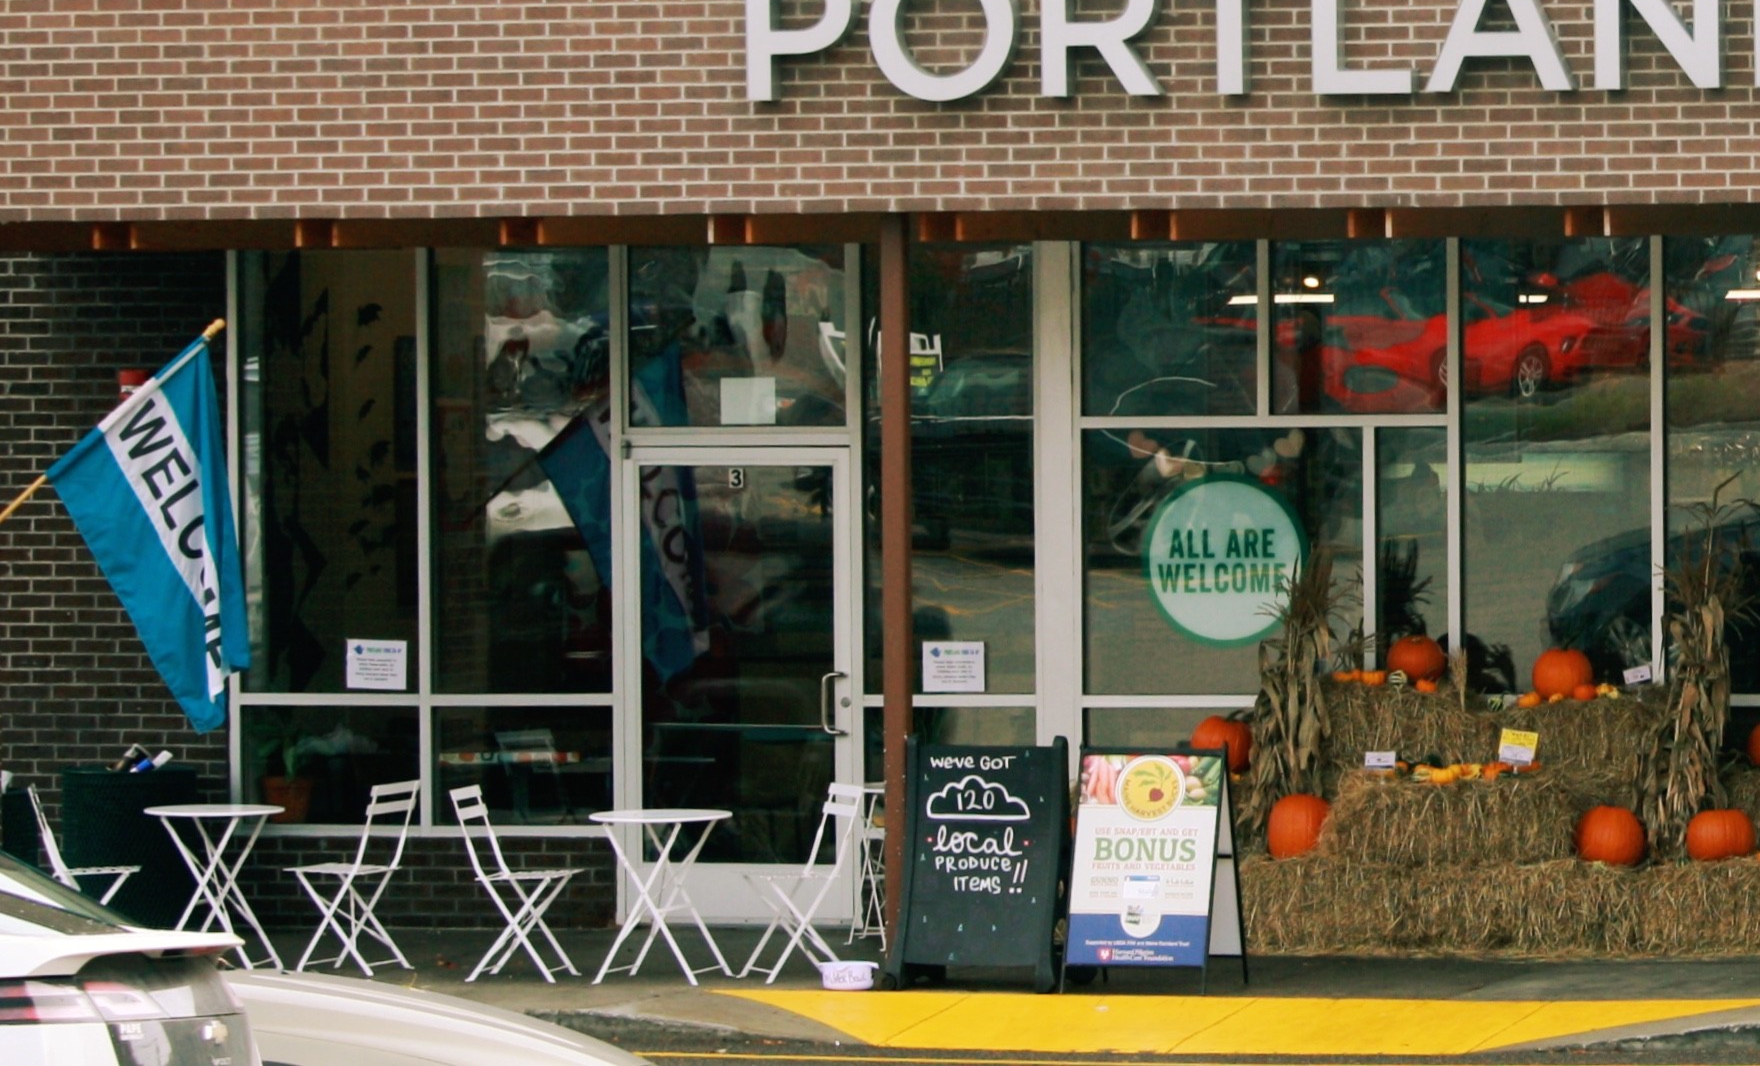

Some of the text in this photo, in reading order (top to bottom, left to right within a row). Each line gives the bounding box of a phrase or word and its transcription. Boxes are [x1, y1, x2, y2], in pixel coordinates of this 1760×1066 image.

[731, 469, 743, 487] 3
[1169, 528, 1275, 559] ALL ARE
[1158, 562, 1286, 593] WELCOME
[957, 790, 995, 811] 120
[933, 825, 1022, 856] local
[1093, 837, 1196, 862] BONUS
